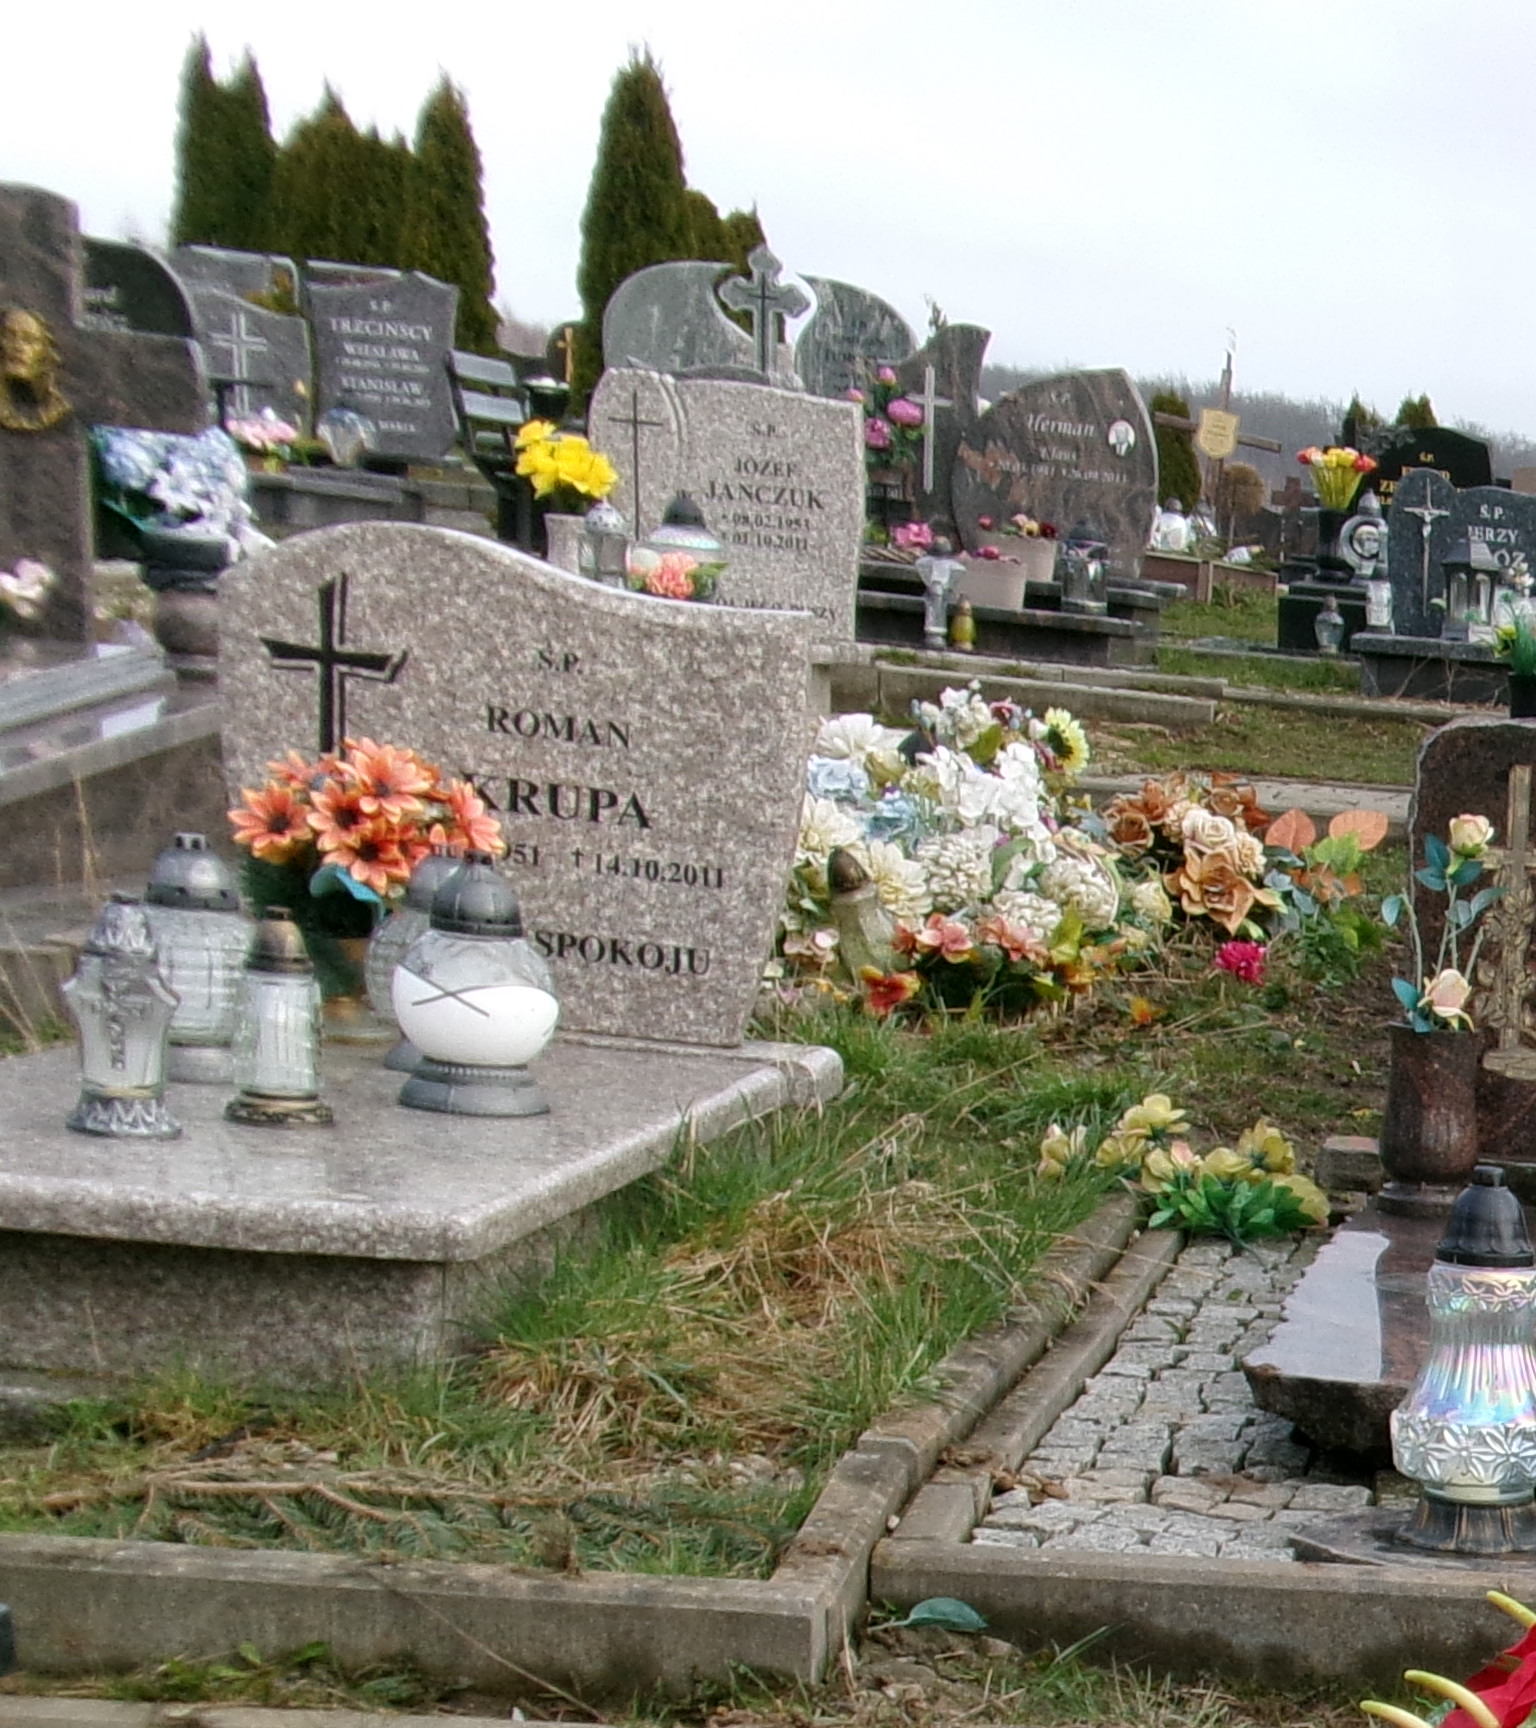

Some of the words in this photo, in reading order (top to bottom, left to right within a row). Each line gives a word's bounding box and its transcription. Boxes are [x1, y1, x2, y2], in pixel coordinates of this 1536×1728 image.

[484, 703, 633, 749] ROMAN
[461, 771, 653, 831] KRUPA
[594, 851, 725, 890] 14.10.2011
[531, 929, 712, 977] SPOKOJU
